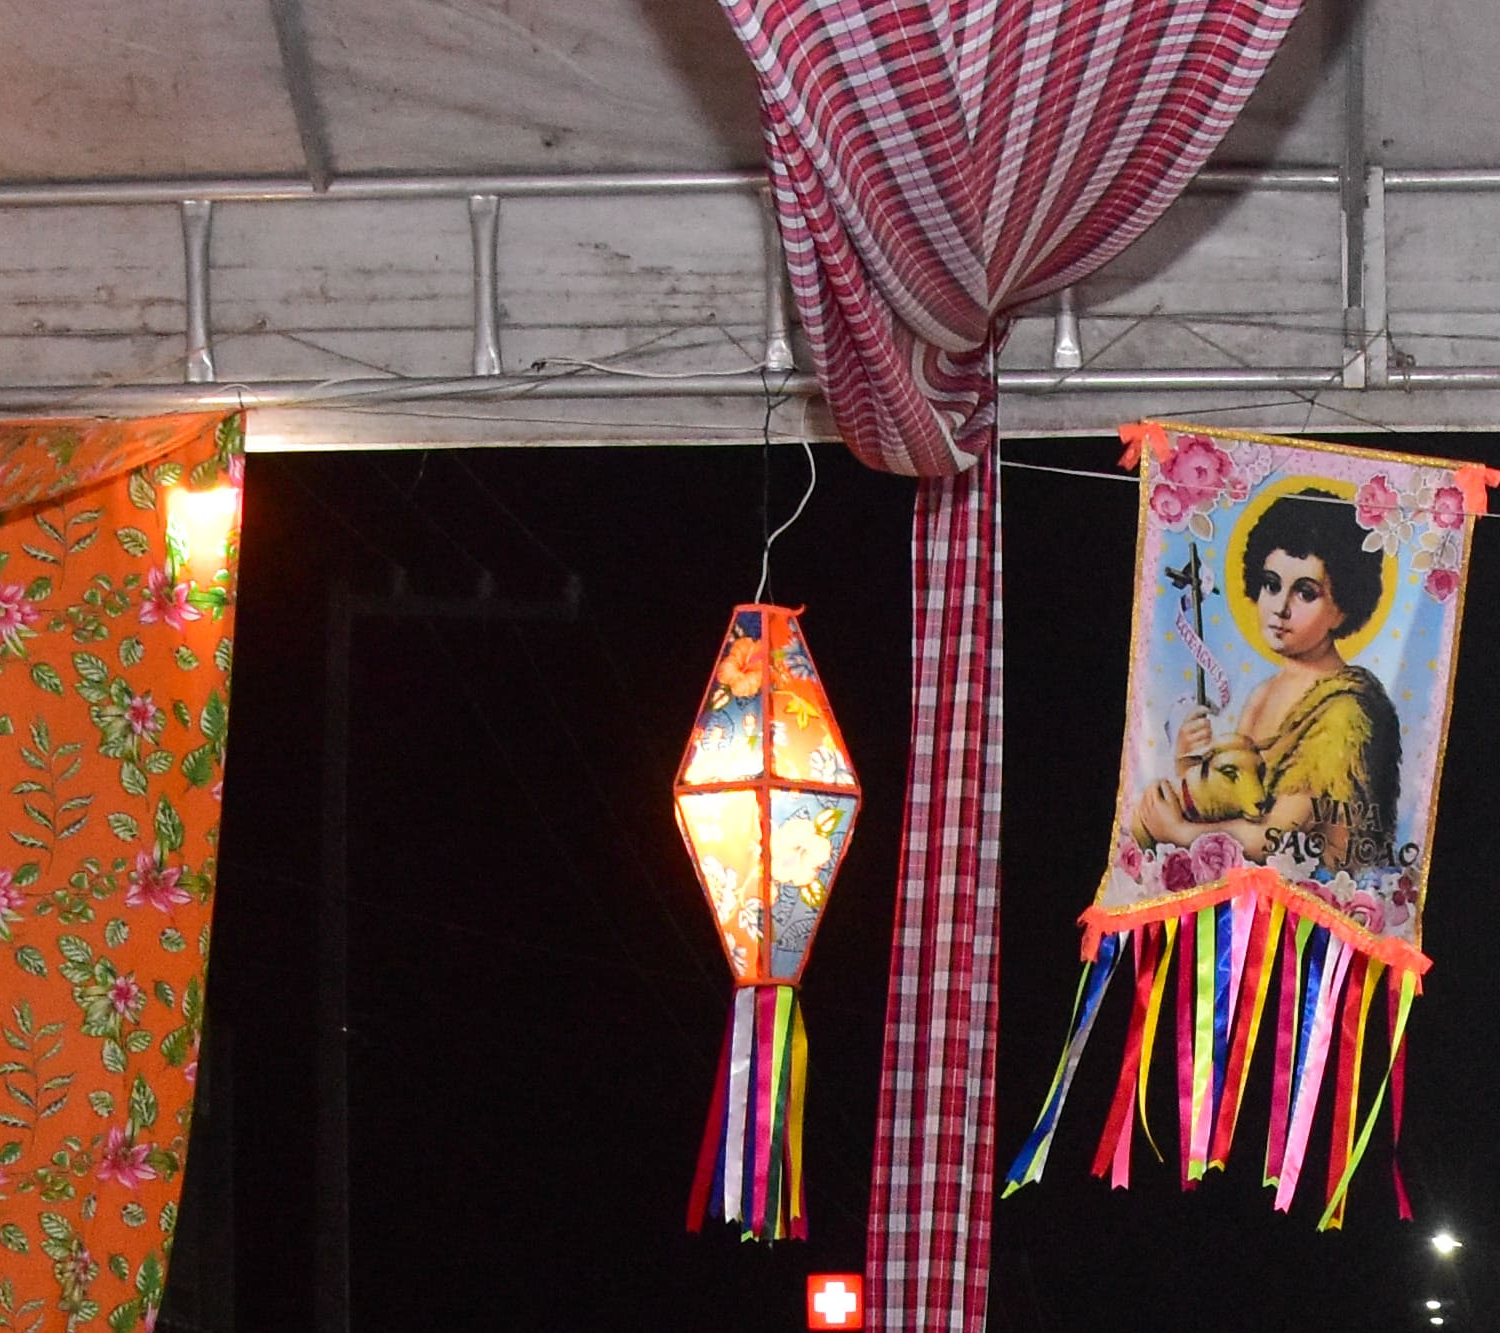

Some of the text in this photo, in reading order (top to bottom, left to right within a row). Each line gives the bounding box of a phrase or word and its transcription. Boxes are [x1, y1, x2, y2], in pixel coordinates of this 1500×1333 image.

[1311, 798, 1382, 832] VIVA
[1263, 821, 1419, 868] SÃO JOÃO
